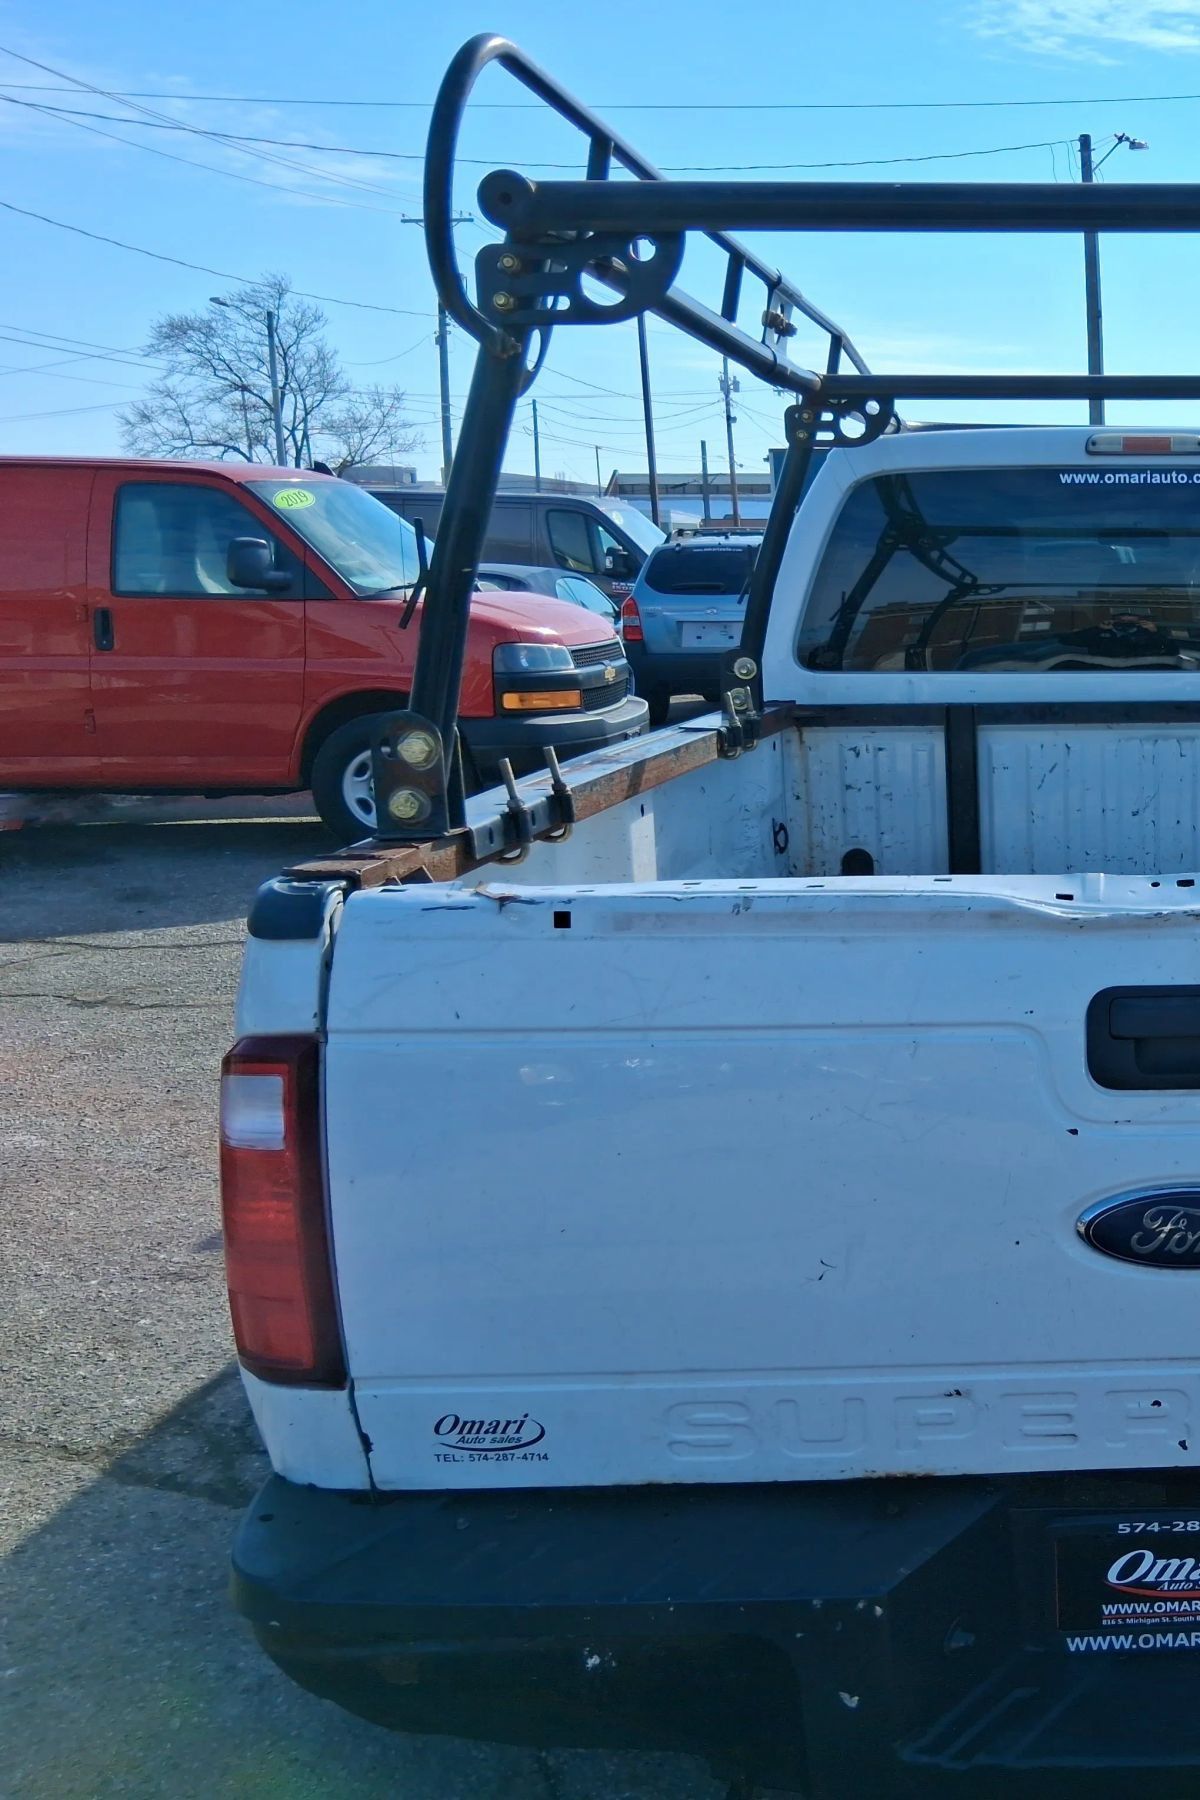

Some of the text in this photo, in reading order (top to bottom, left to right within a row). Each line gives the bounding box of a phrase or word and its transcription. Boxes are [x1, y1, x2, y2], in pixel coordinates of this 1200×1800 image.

[281, 490, 309, 507] 2019
[433, 1412, 529, 1436] Omari
[665, 1389, 1192, 1461] SUPER
[456, 1434, 523, 1445] Auto sales
[434, 1452, 549, 1463] TEL: 574-287-4714
[1156, 1580, 1194, 1592] Auto
[1126, 1616, 1160, 1626] Michigan
[1173, 1615, 1195, 1623] South
